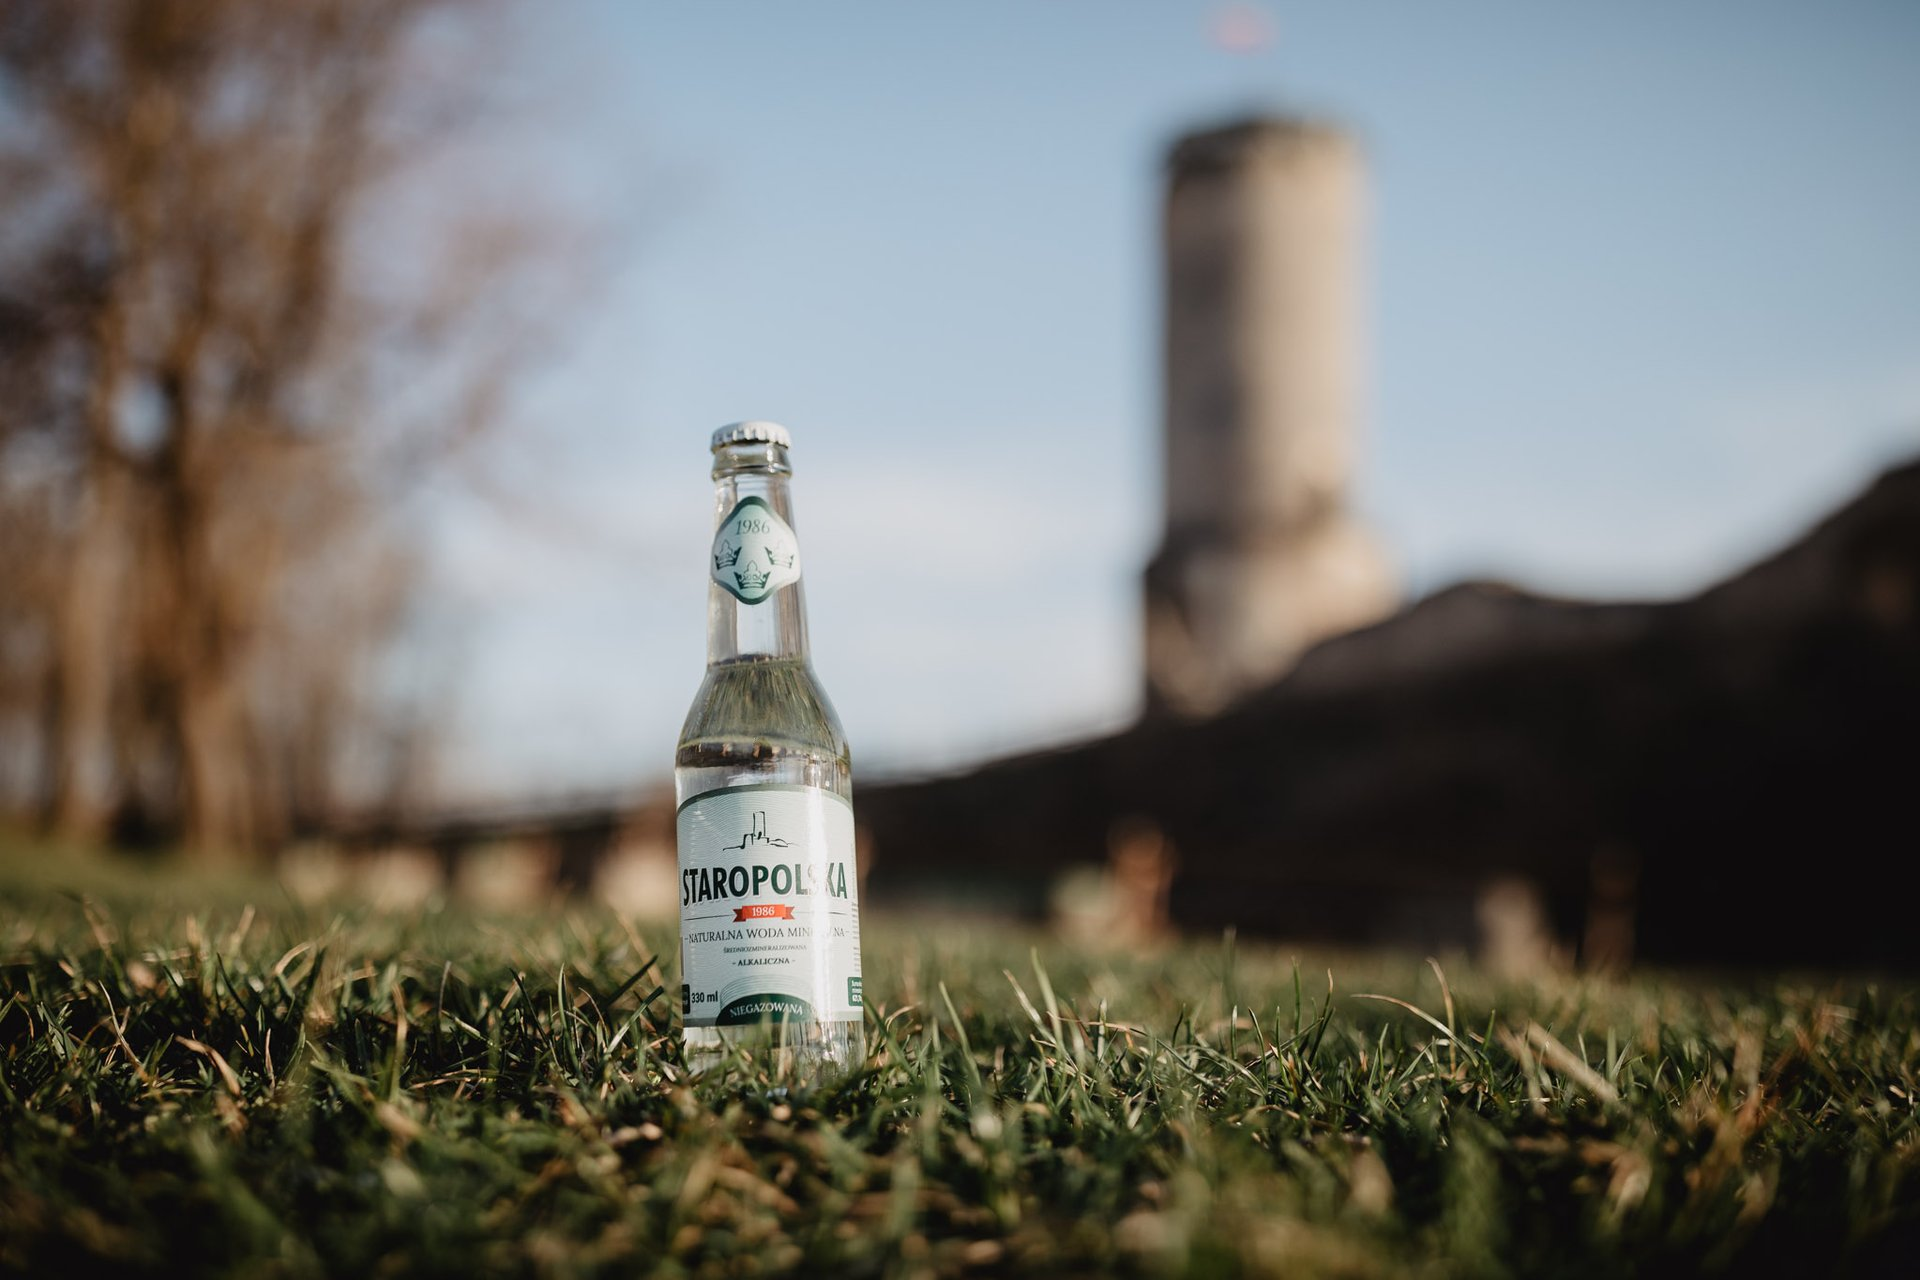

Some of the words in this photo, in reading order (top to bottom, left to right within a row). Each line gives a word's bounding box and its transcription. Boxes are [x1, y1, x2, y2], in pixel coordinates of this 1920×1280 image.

[736, 520, 770, 535] 1986
[752, 906, 775, 917] 1986
[688, 929, 744, 944] NATURALNA
[746, 927, 784, 939] WODA
[787, 926, 845, 938] MINNA
[737, 957, 790, 967] ALKALICZNA
[691, 992, 705, 1004] 330
[706, 990, 718, 1003] ml
[729, 1001, 804, 1018] NIEGAZOWANA
